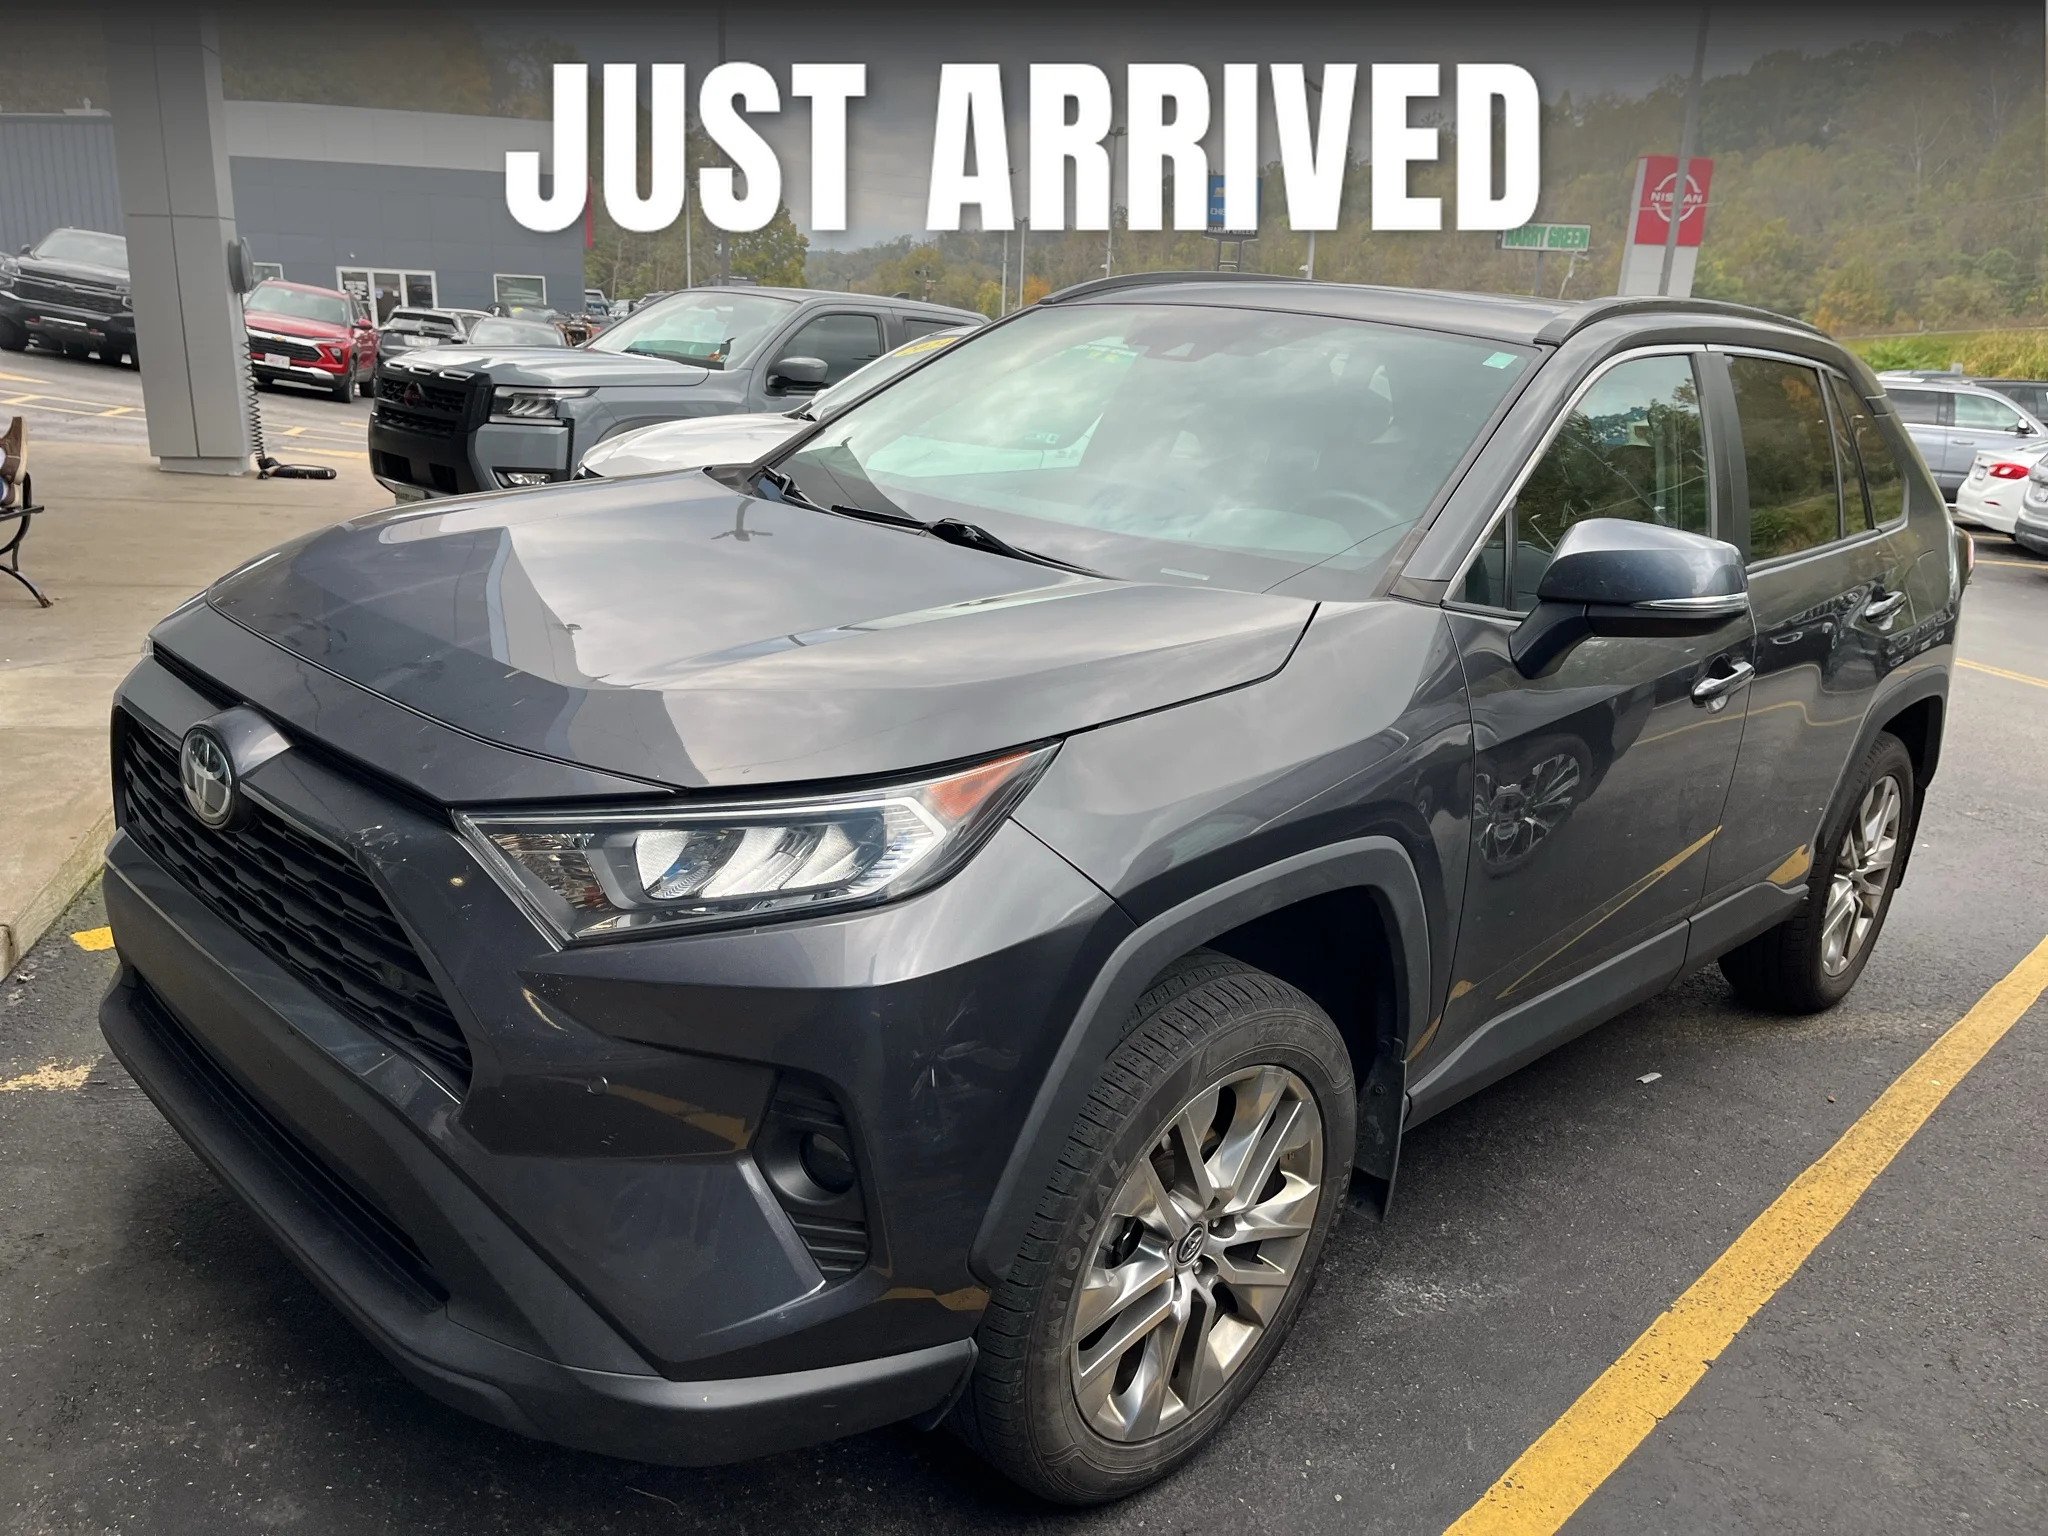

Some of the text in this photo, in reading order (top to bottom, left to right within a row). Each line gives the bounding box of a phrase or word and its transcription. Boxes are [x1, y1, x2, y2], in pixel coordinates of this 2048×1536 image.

[1650, 191, 1703, 204] NISAN
[1547, 226, 1589, 249] GREEN
[1043, 1158, 1127, 1358] ATIONAL
